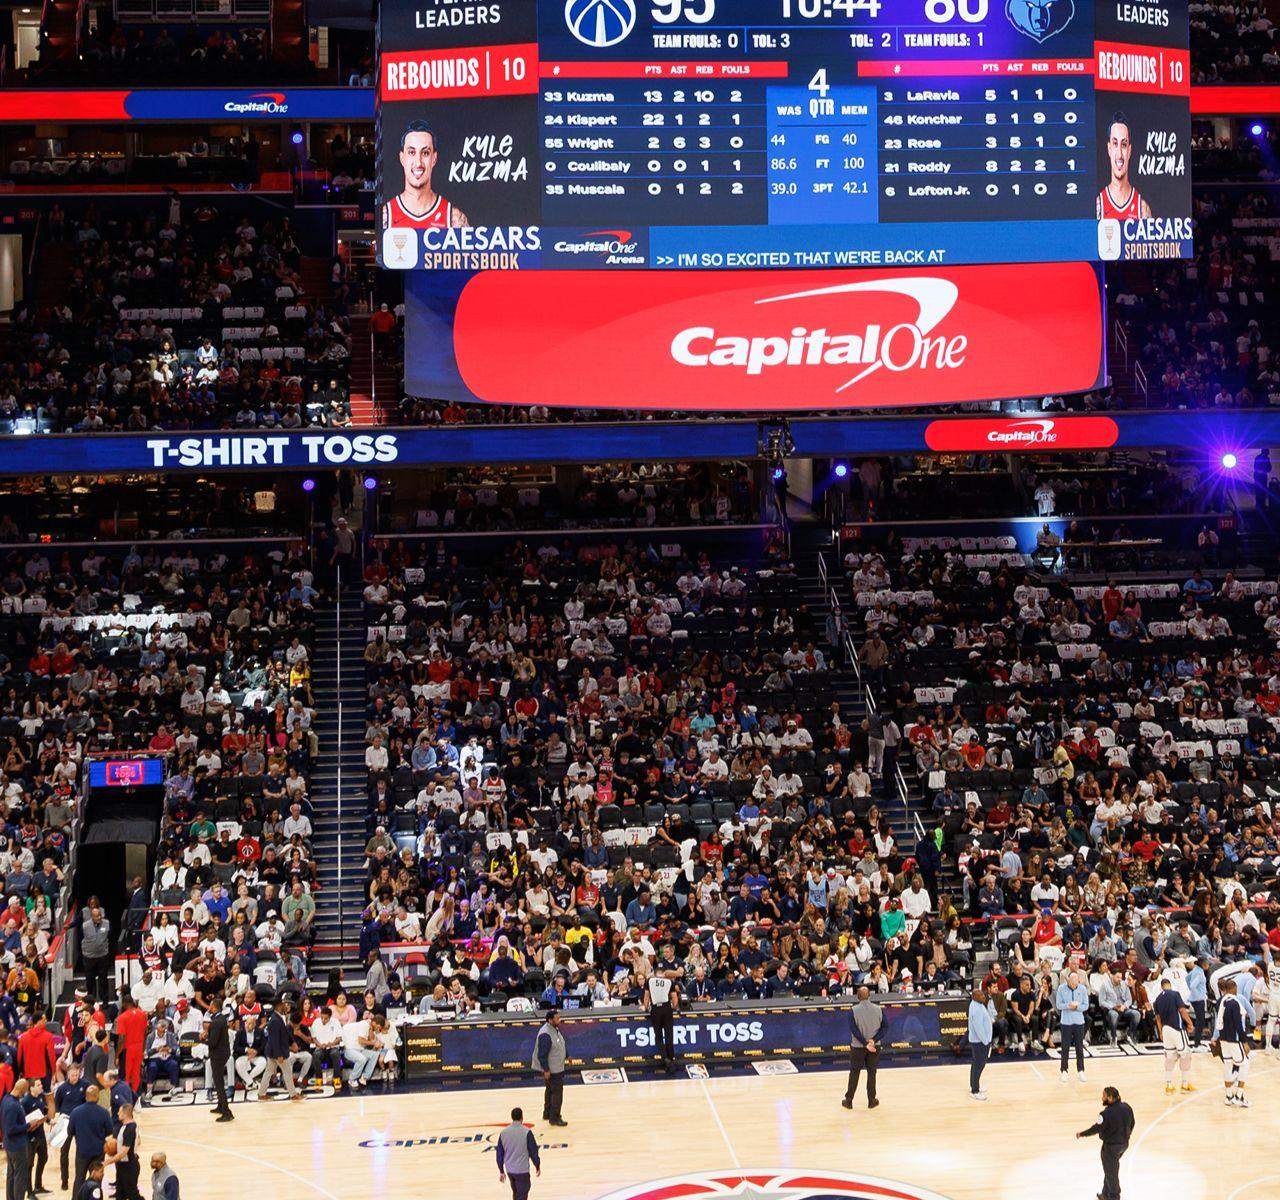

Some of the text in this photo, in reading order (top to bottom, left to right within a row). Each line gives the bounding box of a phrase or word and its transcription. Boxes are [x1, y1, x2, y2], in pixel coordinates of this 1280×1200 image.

[415, 5, 501, 29] LEADERS
[1117, 4, 1169, 27] LEADERS
[653, 34, 738, 48] TEAM FOULS: 0
[752, 33, 791, 48] TOL: 3
[850, 33, 891, 48] TOL: 2
[904, 32, 984, 47] TEAM FOULS: 1
[387, 57, 526, 90] REBOUNDS 10
[644, 65, 750, 74] PTS AST REB FOULS
[982, 63, 1084, 72] PTS AST REB FOULS
[1098, 51, 1183, 84] REBOUNDS 10
[808, 69, 830, 97] 4
[544, 91, 742, 102] 33 Kuzma 13 2 10 2
[884, 88, 1077, 101] 3 LaRavia 5 1 1 0
[777, 106, 801, 115] WAS
[809, 99, 834, 118] QTR
[841, 106, 867, 115] MEM
[544, 113, 740, 127] 24 Kispert 22 1 2 1
[884, 112, 1077, 125] 46 Konchar 5 1 9 0
[544, 138, 614, 150] 55 Wright
[770, 134, 857, 146] 44 FG 40
[884, 139, 942, 149] 23 Rose
[448, 157, 528, 183] KUZMA
[545, 160, 741, 173] 0 Coulibaly 0 0 1 1
[771, 158, 865, 170] 86.6 FT 100
[884, 159, 1075, 174] 21 Roddy 8 2 2 1
[1138, 154, 1185, 176] KUZMA
[545, 184, 625, 195] 35 Muscala
[771, 182, 868, 194] 39.0 3PT 42.1
[885, 185, 970, 196] 6 Lofton Jr.
[1123, 217, 1193, 241] CAESARS
[423, 226, 541, 250] CAESARS
[678, 249, 946, 266] I'M SO EXCITED THAT WE'RE BACK AT
[1124, 242, 1181, 260] SPORTSBOOK
[424, 252, 520, 270] SPORTSBOOK
[605, 255, 645, 265] Arena
[147, 434, 398, 467] T-SHIRT TOSS
[655, 979, 665, 988] 50
[706, 1021, 764, 1043] TOSS
